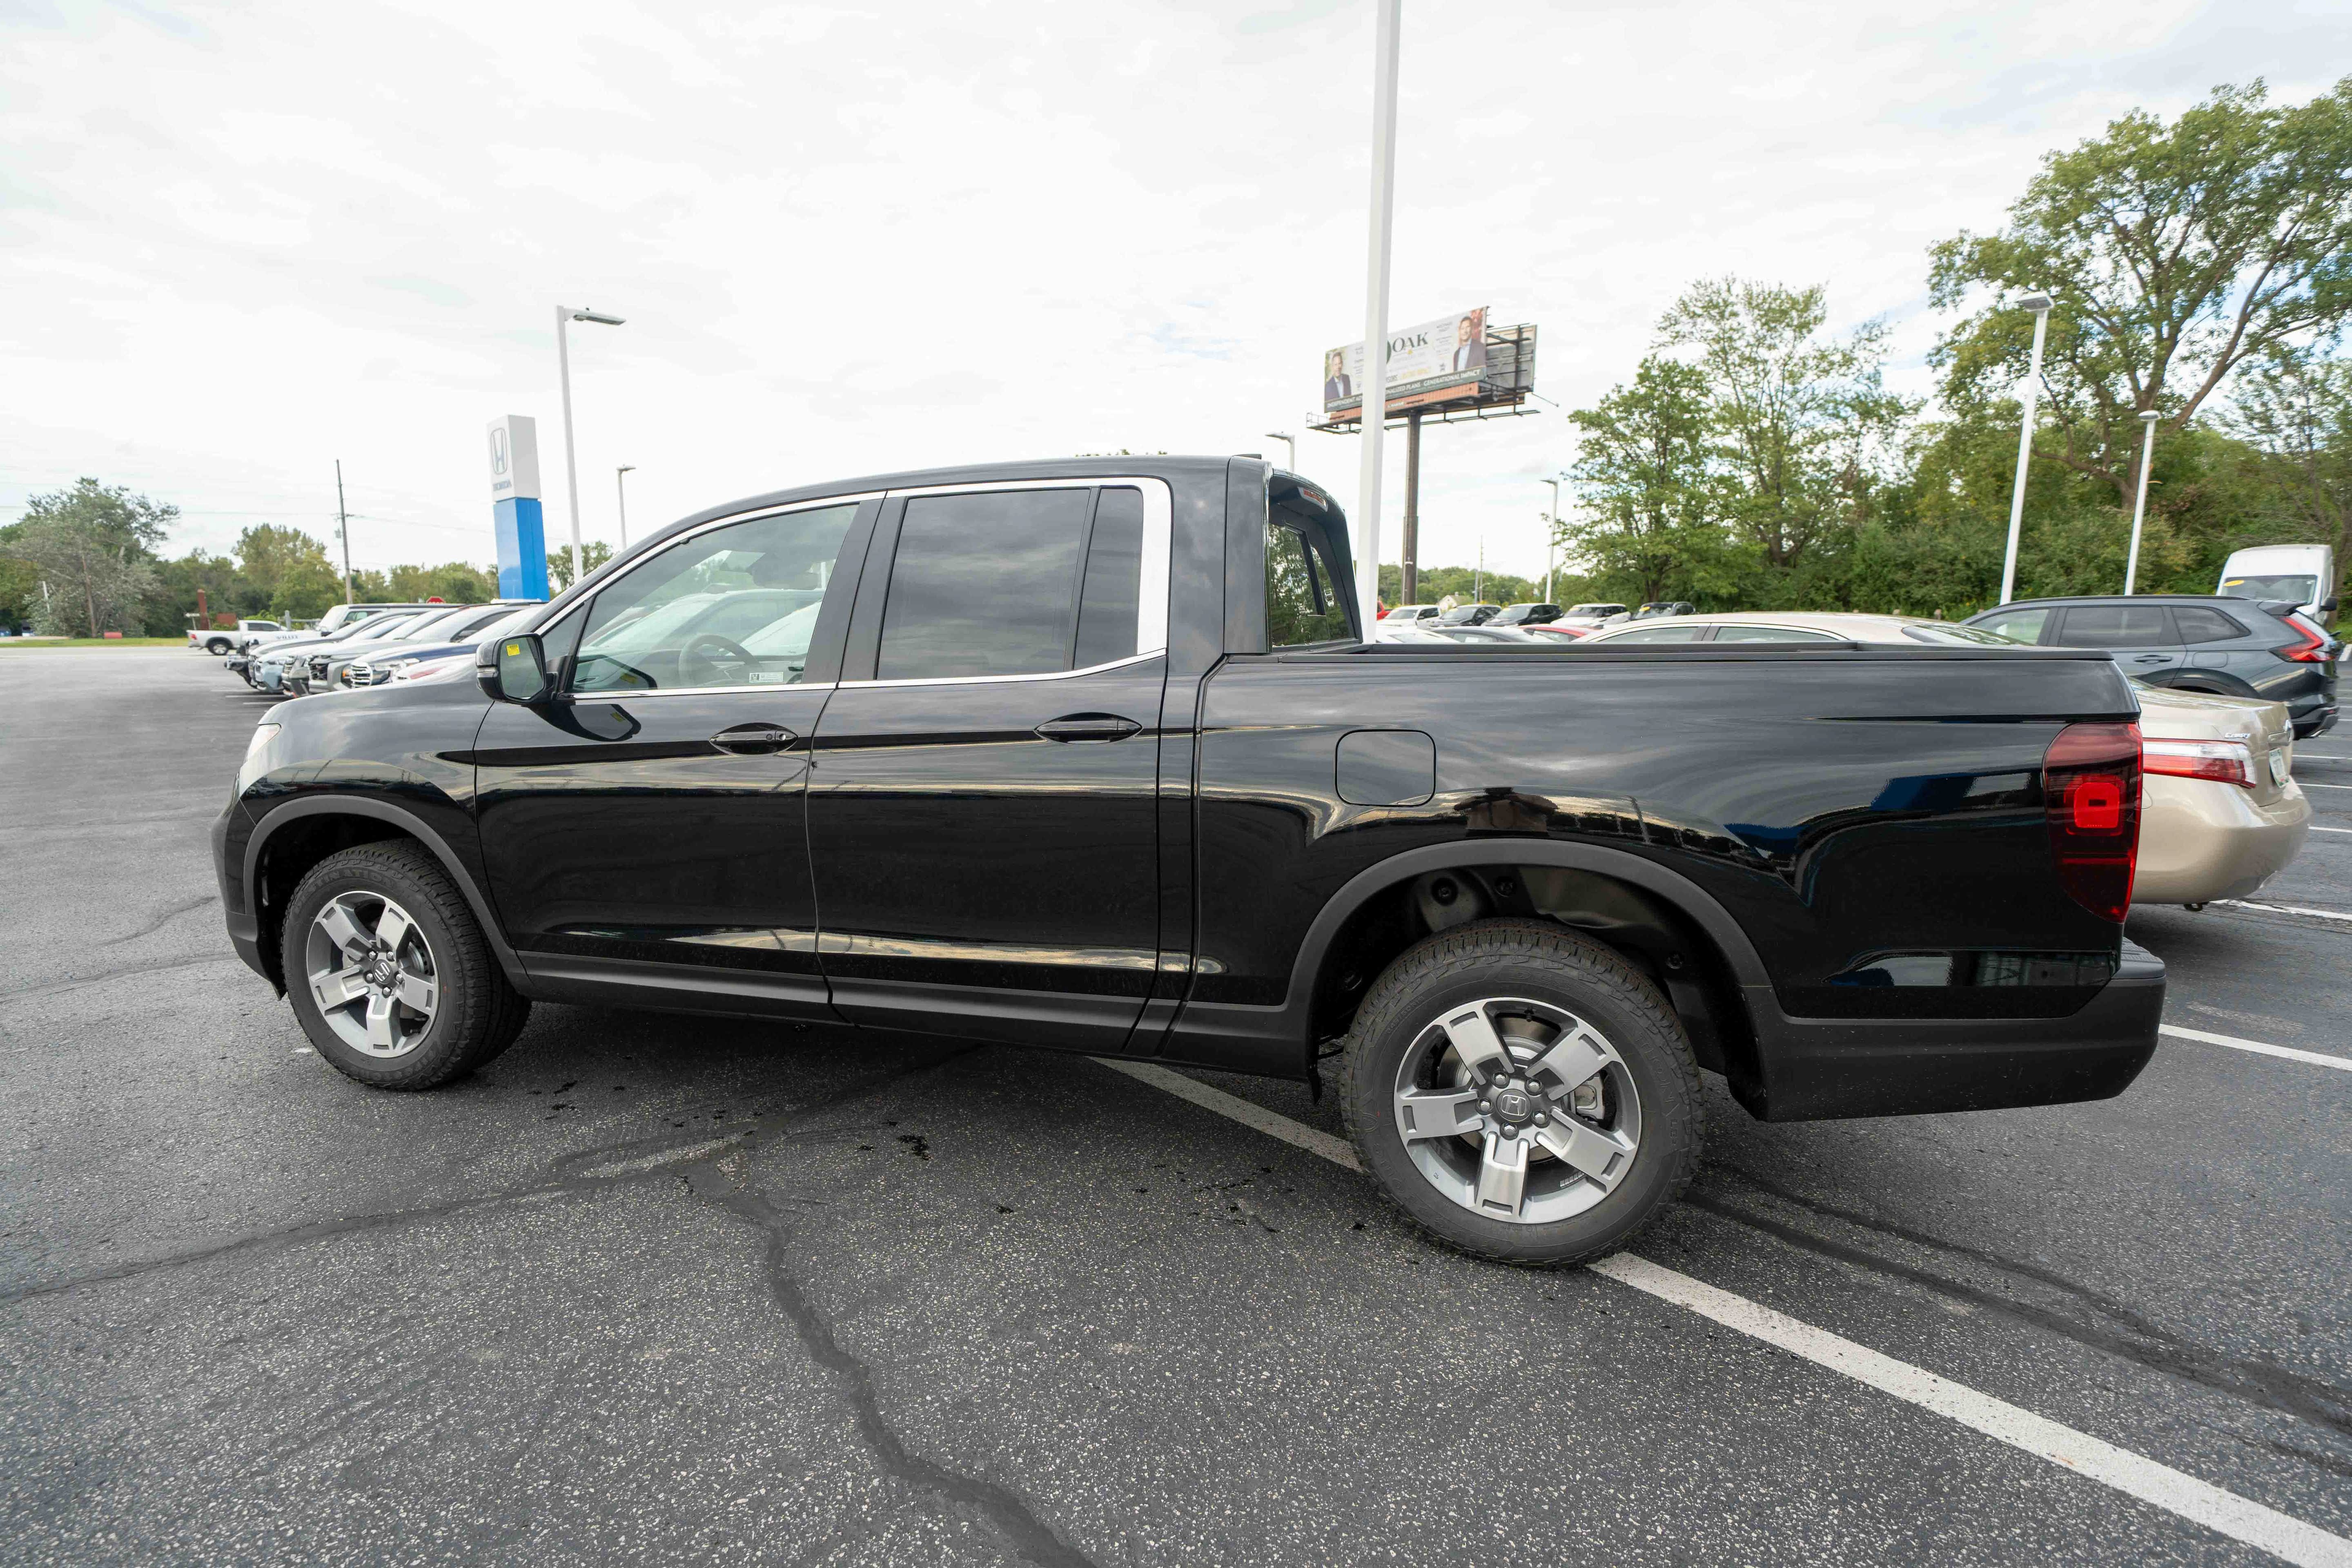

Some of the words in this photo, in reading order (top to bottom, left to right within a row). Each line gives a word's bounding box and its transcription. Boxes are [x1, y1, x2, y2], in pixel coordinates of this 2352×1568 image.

[1392, 332, 1428, 352] OAK
[1423, 373, 1460, 386] GENERATIONAL
[1461, 369, 1480, 379] IMPACT
